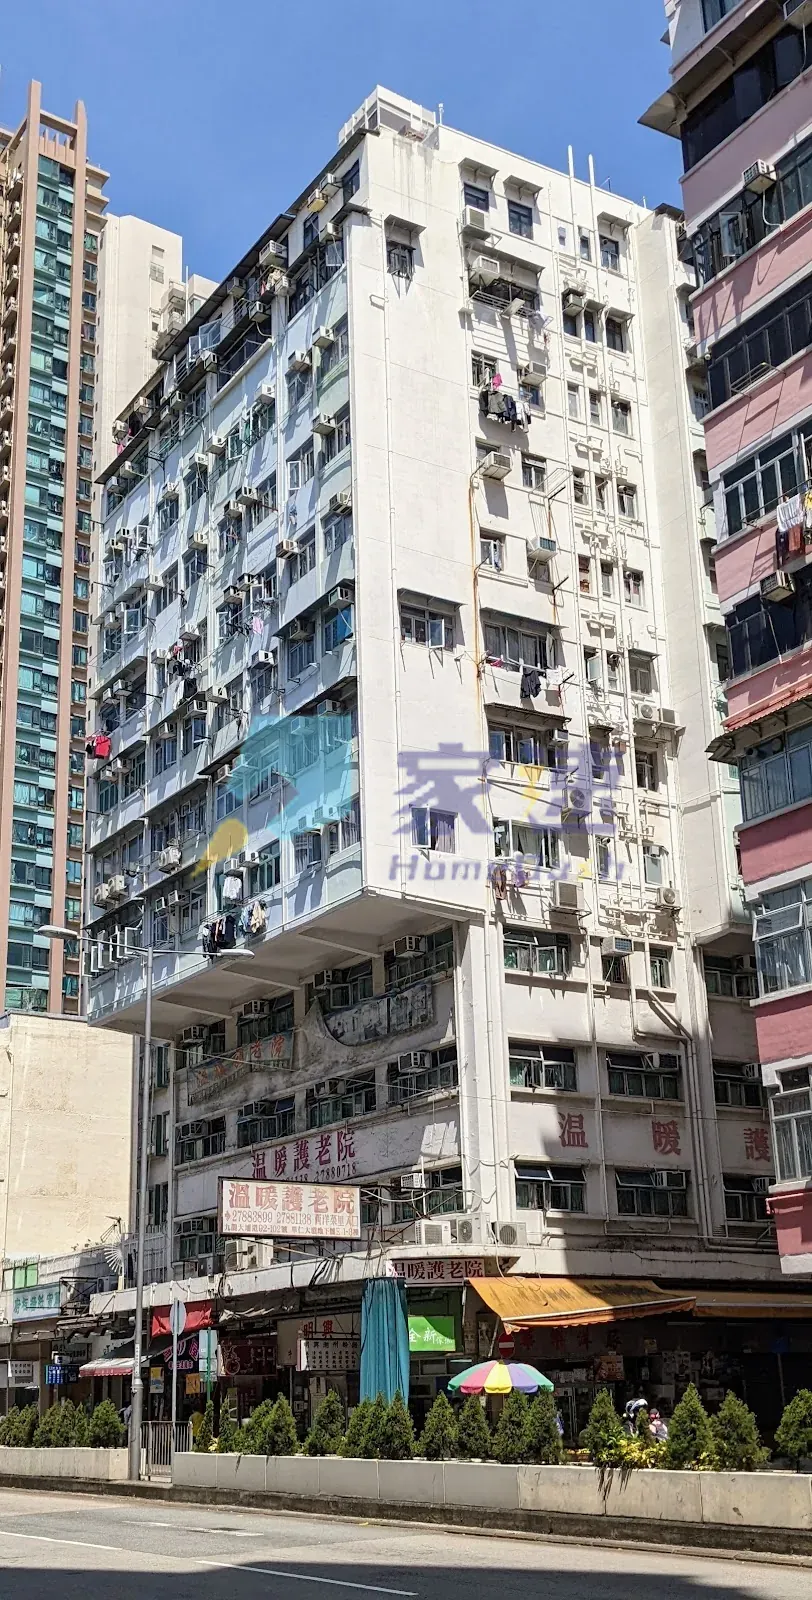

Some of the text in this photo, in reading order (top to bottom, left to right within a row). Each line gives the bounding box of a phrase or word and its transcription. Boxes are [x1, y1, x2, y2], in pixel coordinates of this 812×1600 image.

[228, 1182, 355, 1214] 溫暖護老院
